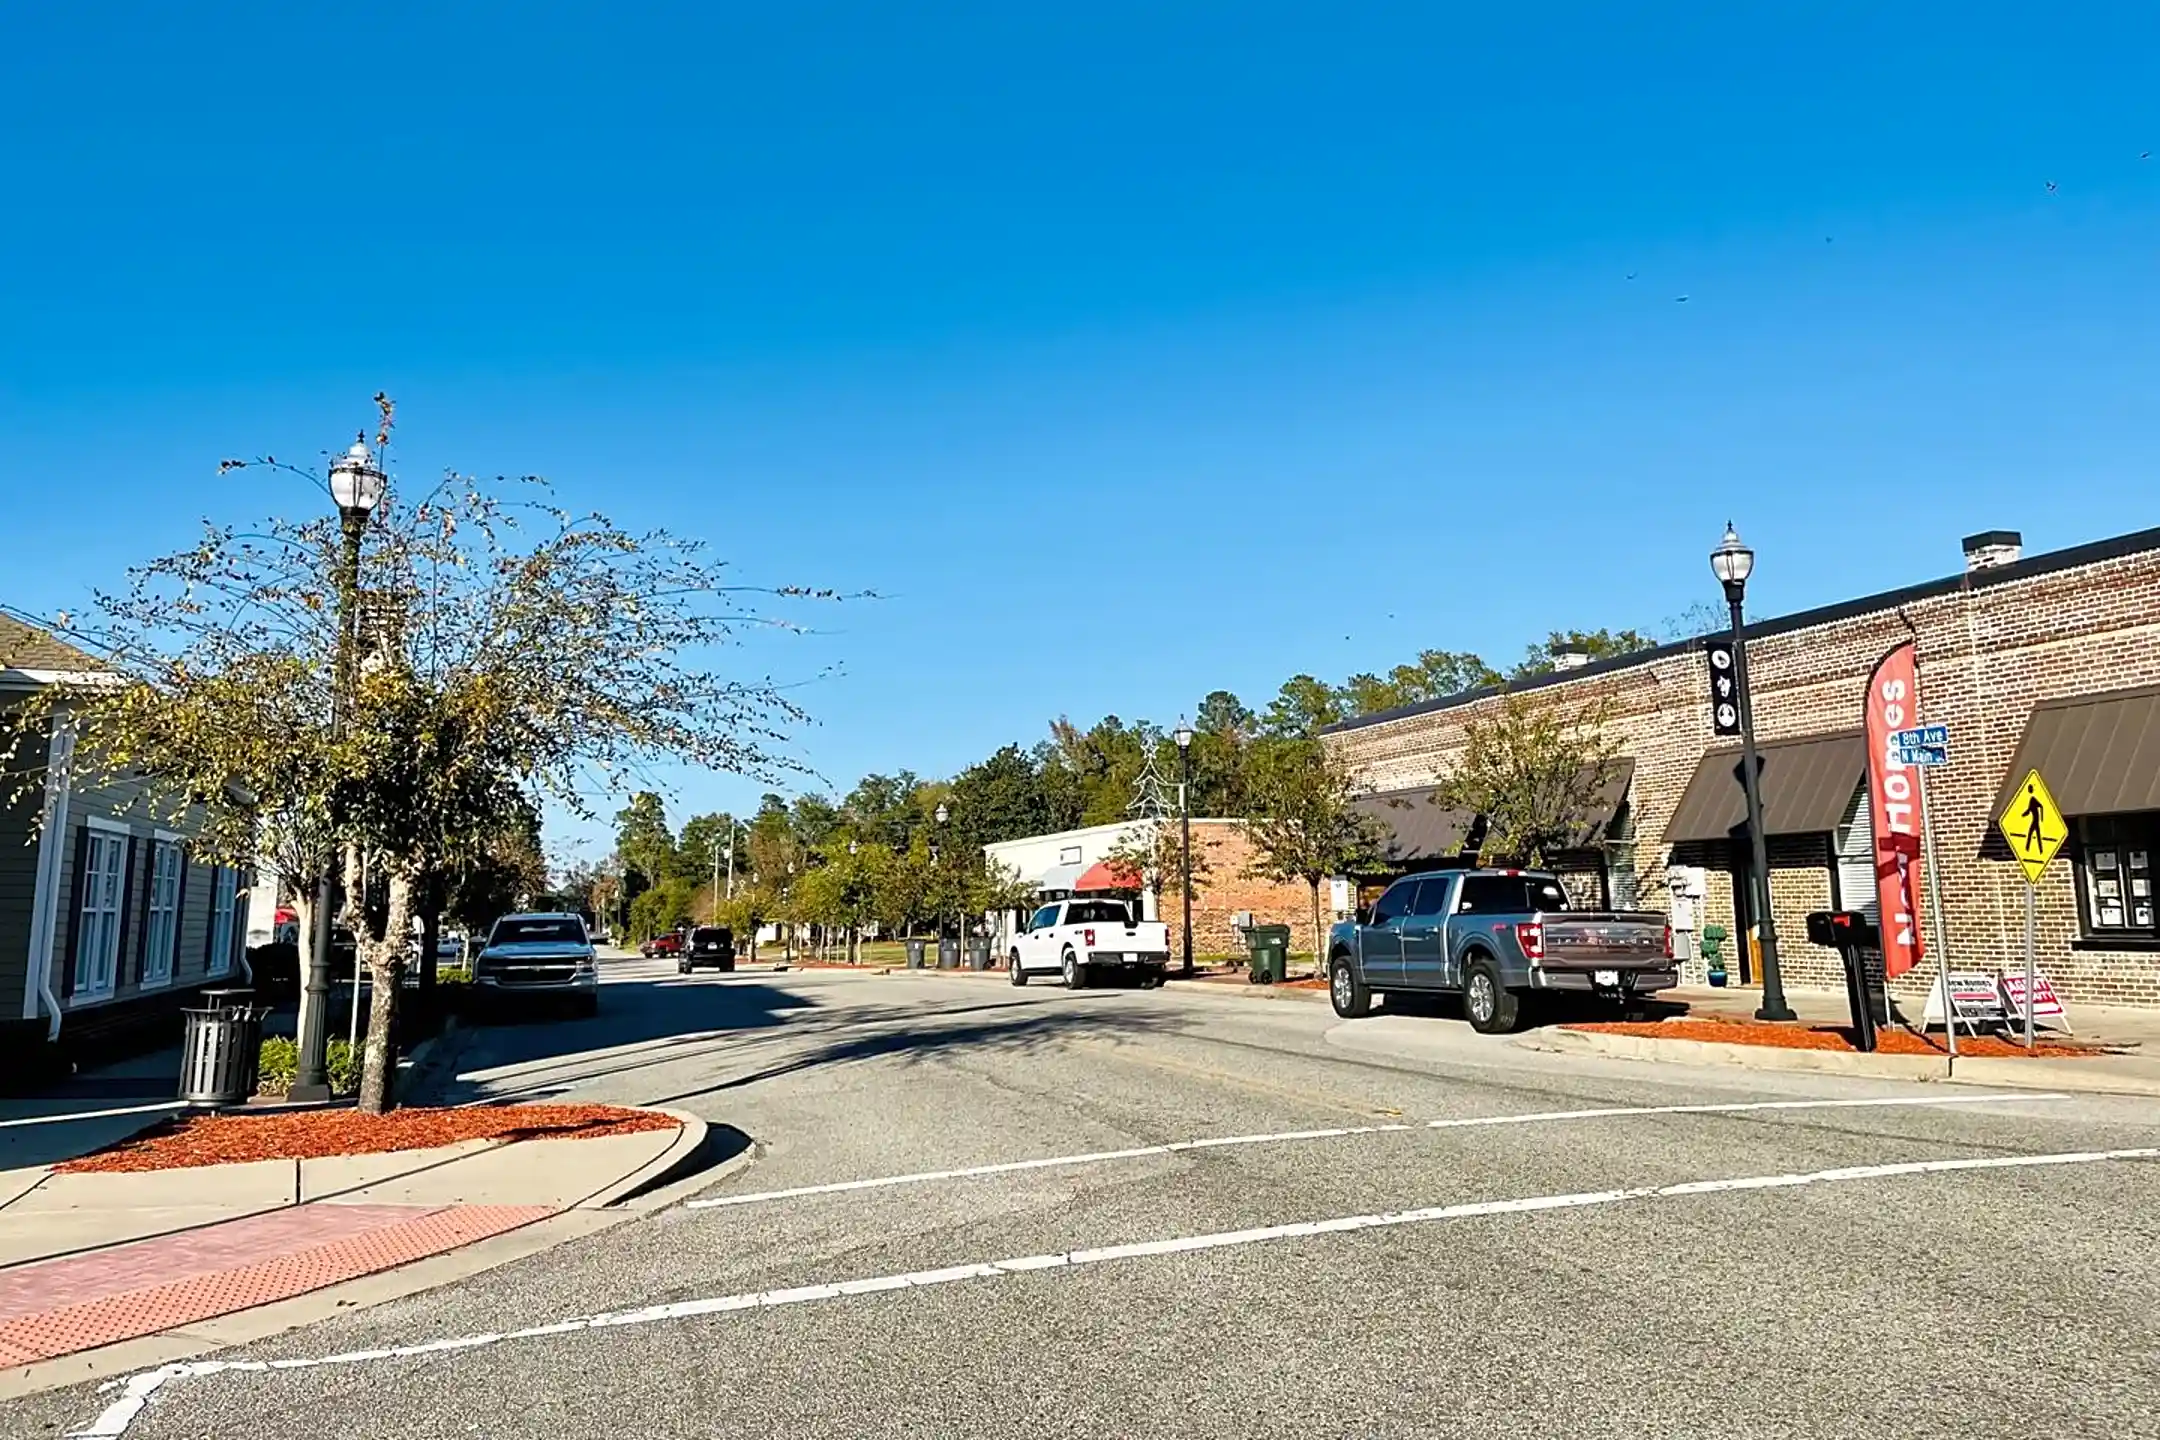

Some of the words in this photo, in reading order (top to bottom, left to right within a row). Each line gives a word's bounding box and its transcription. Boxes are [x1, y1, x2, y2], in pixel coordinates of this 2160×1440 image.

[1902, 731, 1920, 745] 8th
[1923, 729, 1943, 742] Ave
[2006, 979, 2050, 991] AGNT
